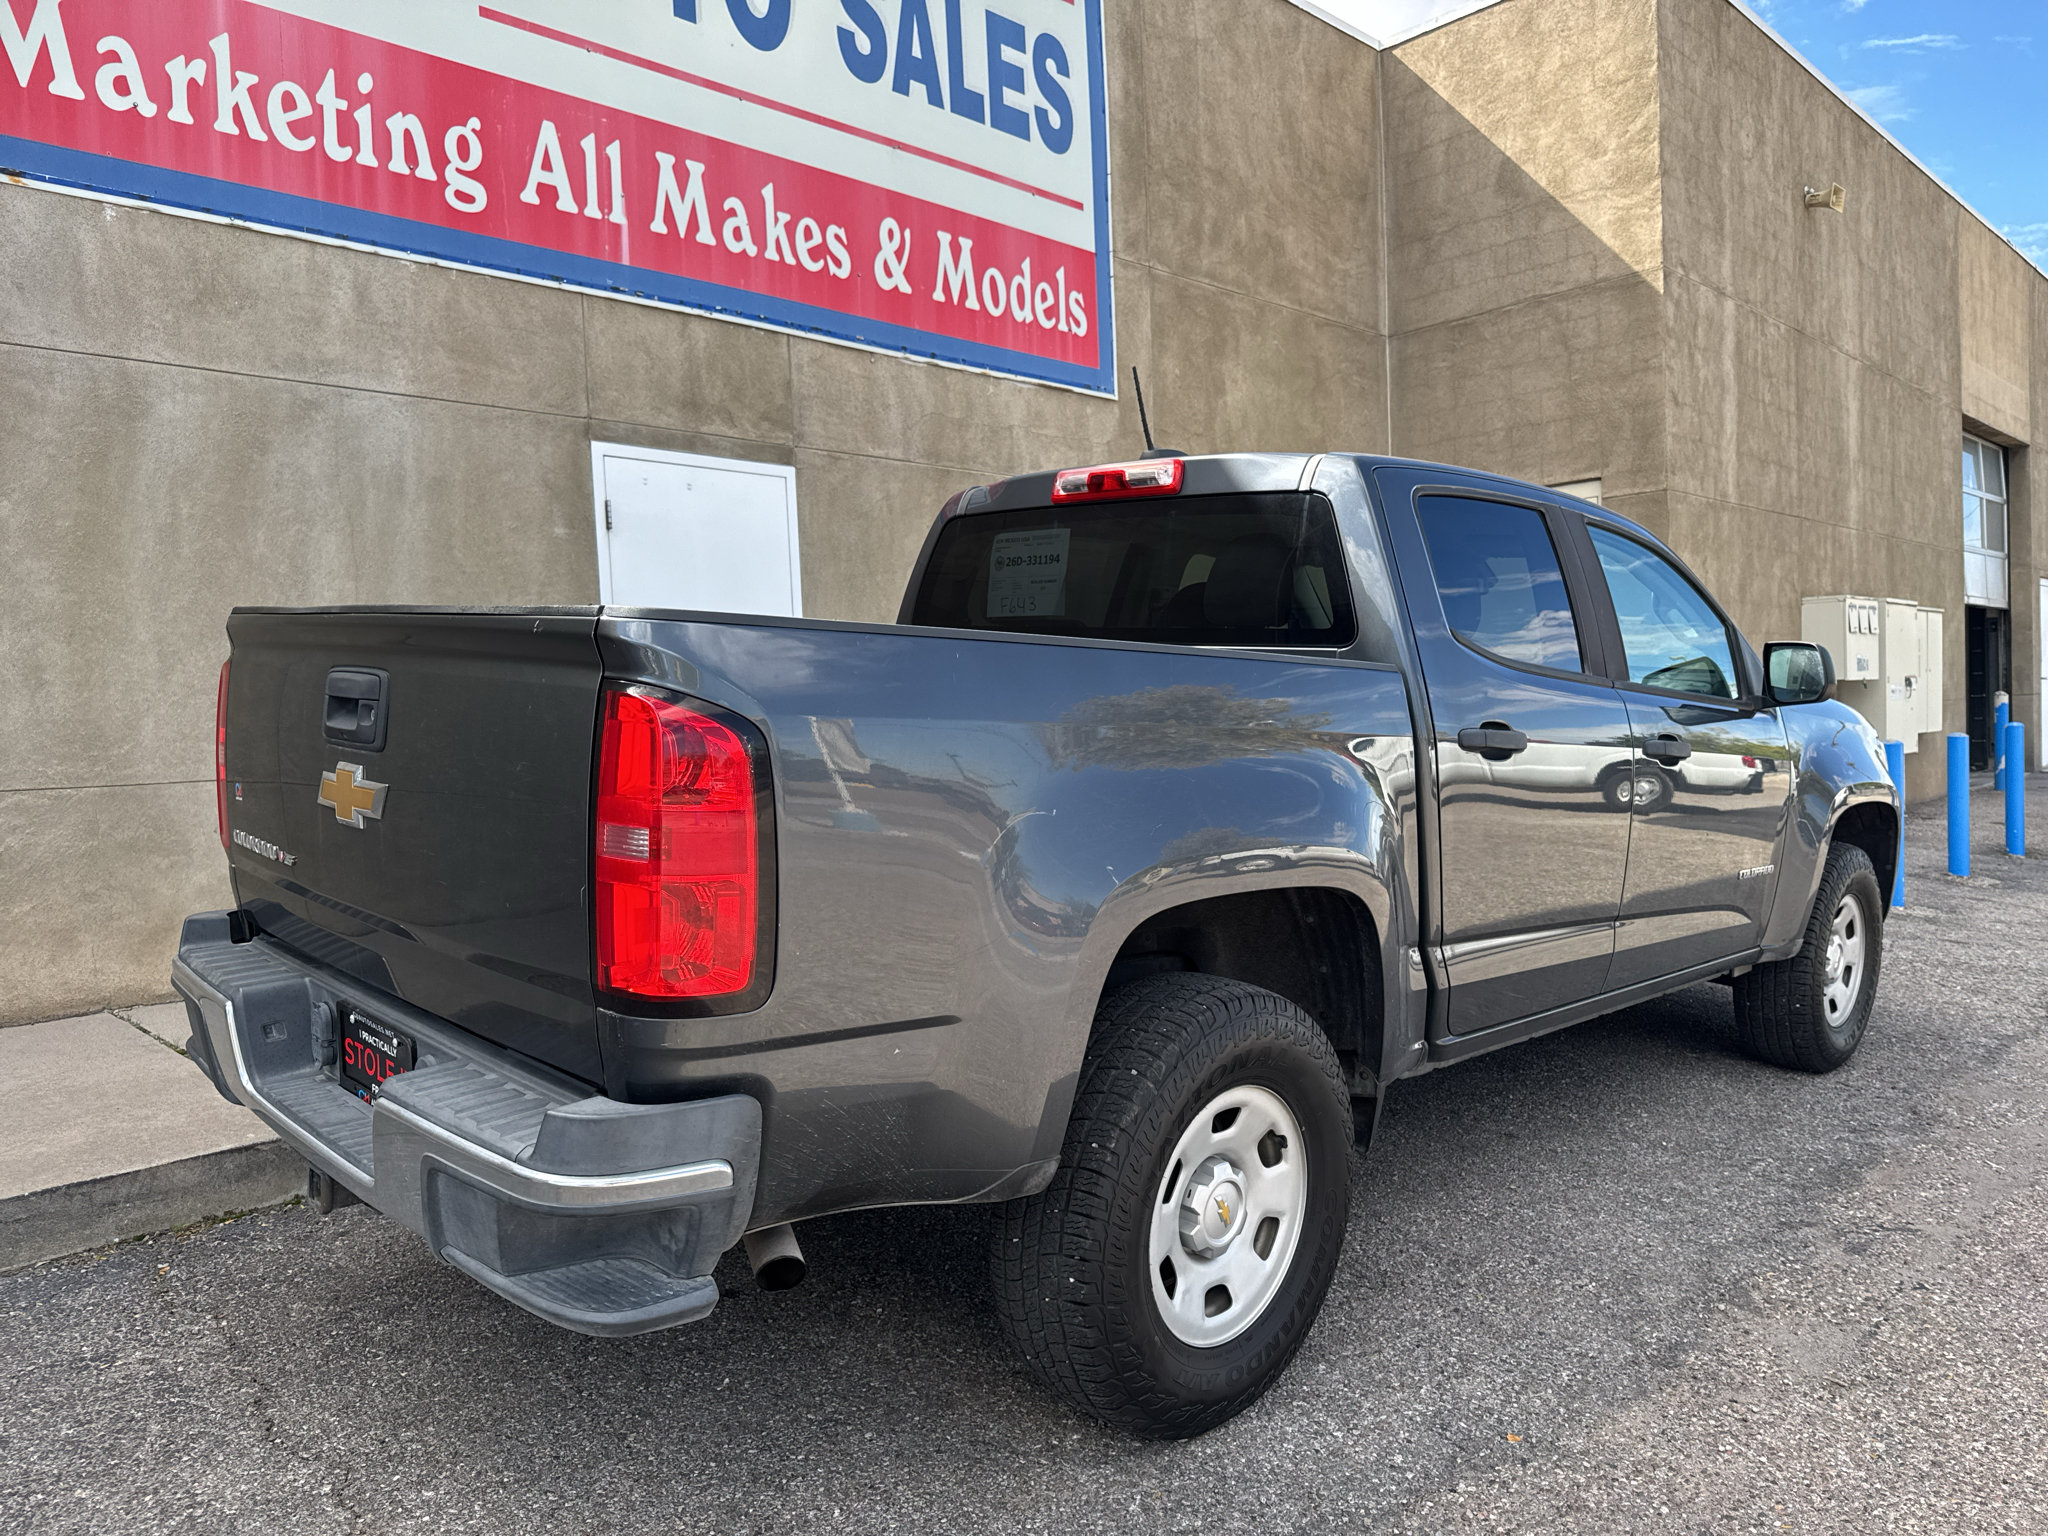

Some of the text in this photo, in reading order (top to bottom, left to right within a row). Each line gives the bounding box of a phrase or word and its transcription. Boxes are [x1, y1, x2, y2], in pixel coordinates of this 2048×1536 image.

[836, 0, 1074, 155] SALES
[0, 0, 1089, 338] Marketing All Makes & Models
[1006, 553, 1060, 567] 26D-331194
[1000, 596, 1037, 614] F643
[344, 1038, 395, 1082] STOLE
[362, 1030, 398, 1058] PRACTICALLY
[1224, 1187, 1340, 1389] COMMANDO
